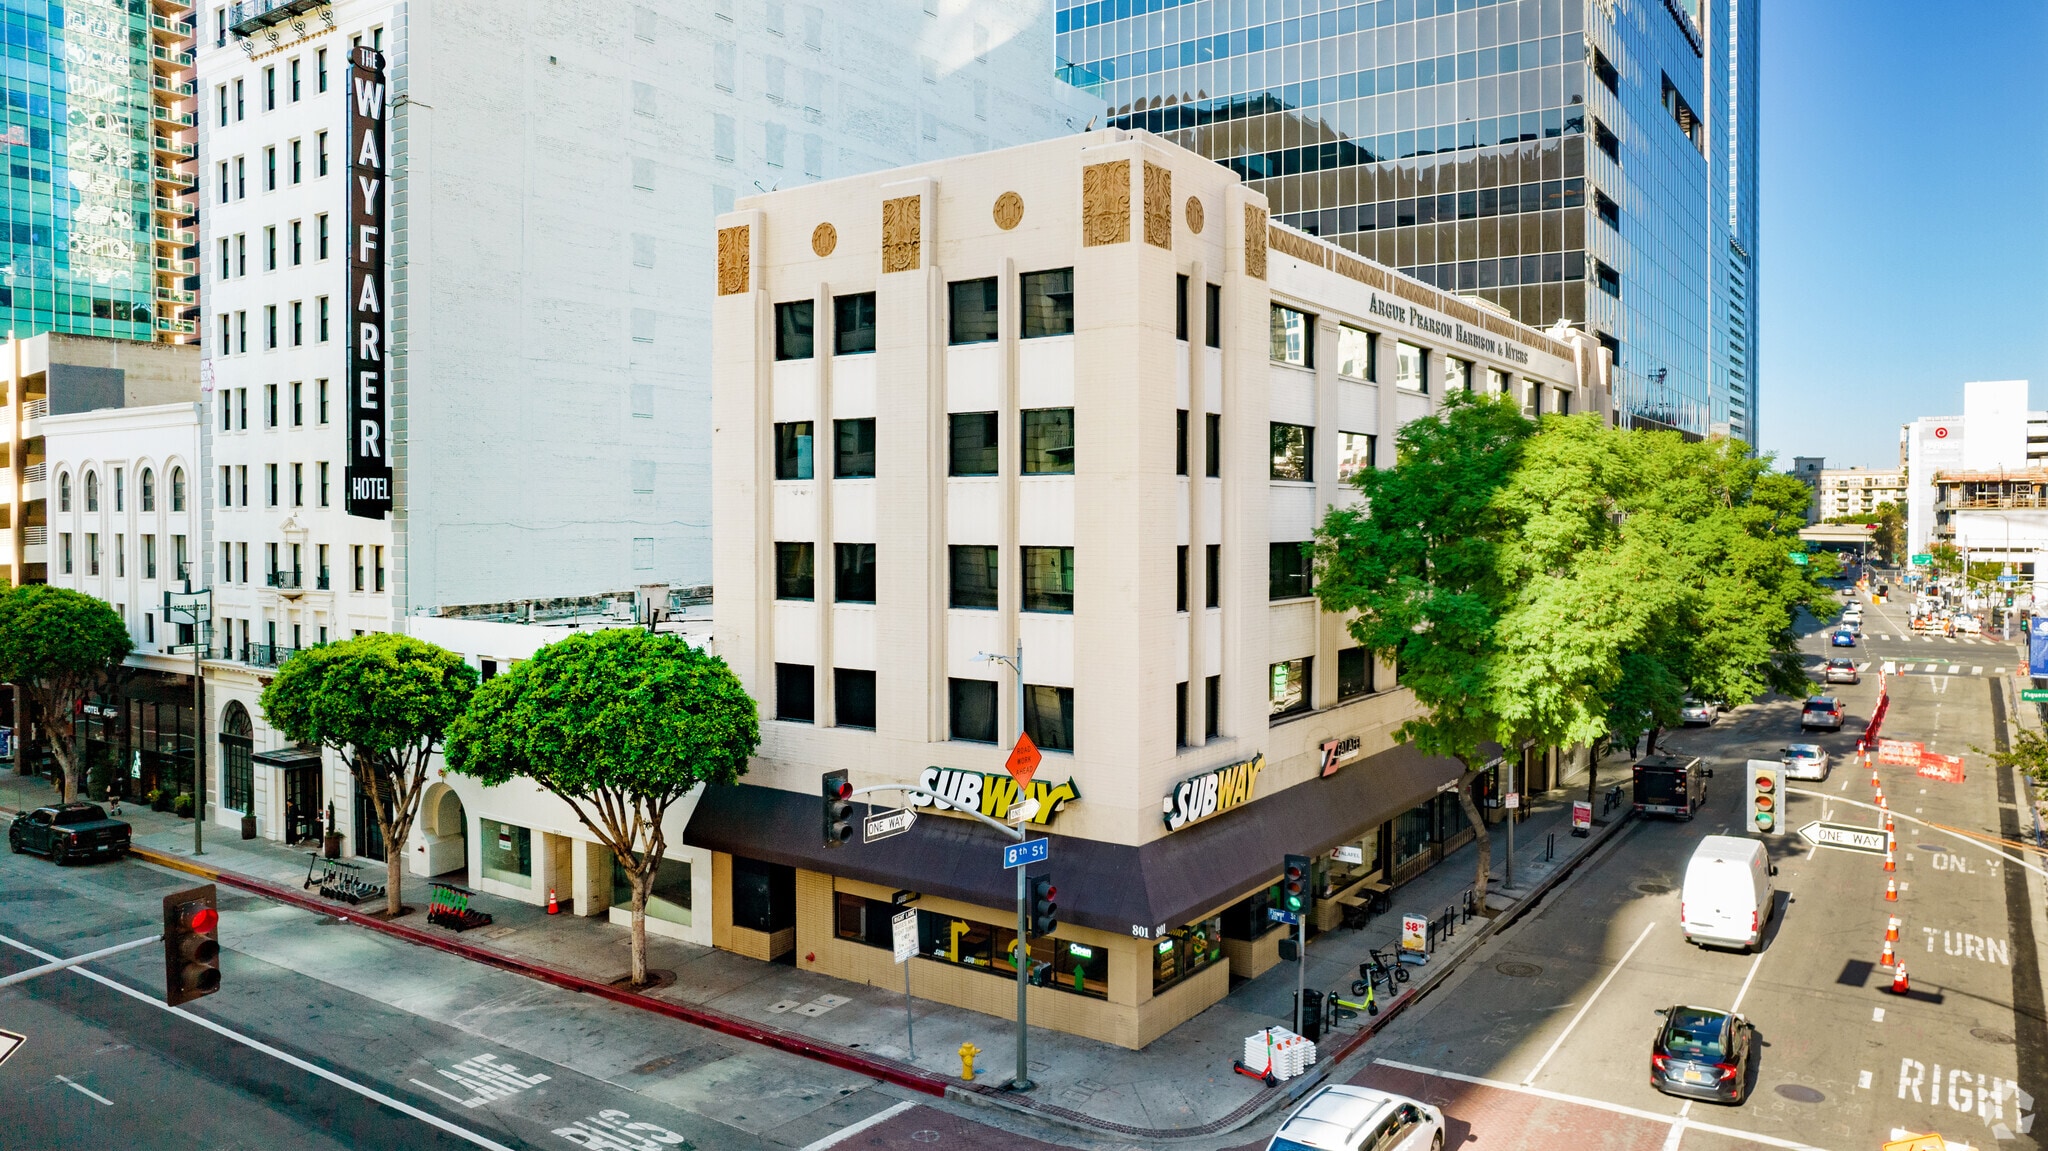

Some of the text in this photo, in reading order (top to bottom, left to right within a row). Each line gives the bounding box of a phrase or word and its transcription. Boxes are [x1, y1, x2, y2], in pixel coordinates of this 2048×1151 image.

[360, 48, 377, 69] THE
[354, 77, 384, 457] WAYFARER
[1369, 292, 1406, 323] ARGUE
[1410, 306, 1453, 341] PEARSON
[1505, 341, 1529, 364] MYERS
[352, 477, 390, 500] HOTEL
[1017, 745, 1031, 754] ROAD
[1017, 756, 1031, 765] WORK
[1016, 766, 1034, 776] AHEAD
[1166, 753, 1266, 831] SUBWAY
[868, 815, 905, 835] ONE WAY
[1818, 829, 1880, 847] ONE WAY
[1008, 844, 1044, 863] 8th St
[1132, 924, 1149, 938] 801
[1155, 923, 1166, 938] 801
[1923, 926, 2010, 965] TURN
[408, 1053, 551, 1109] LANE
[1897, 1057, 2023, 1133] RIGHT
